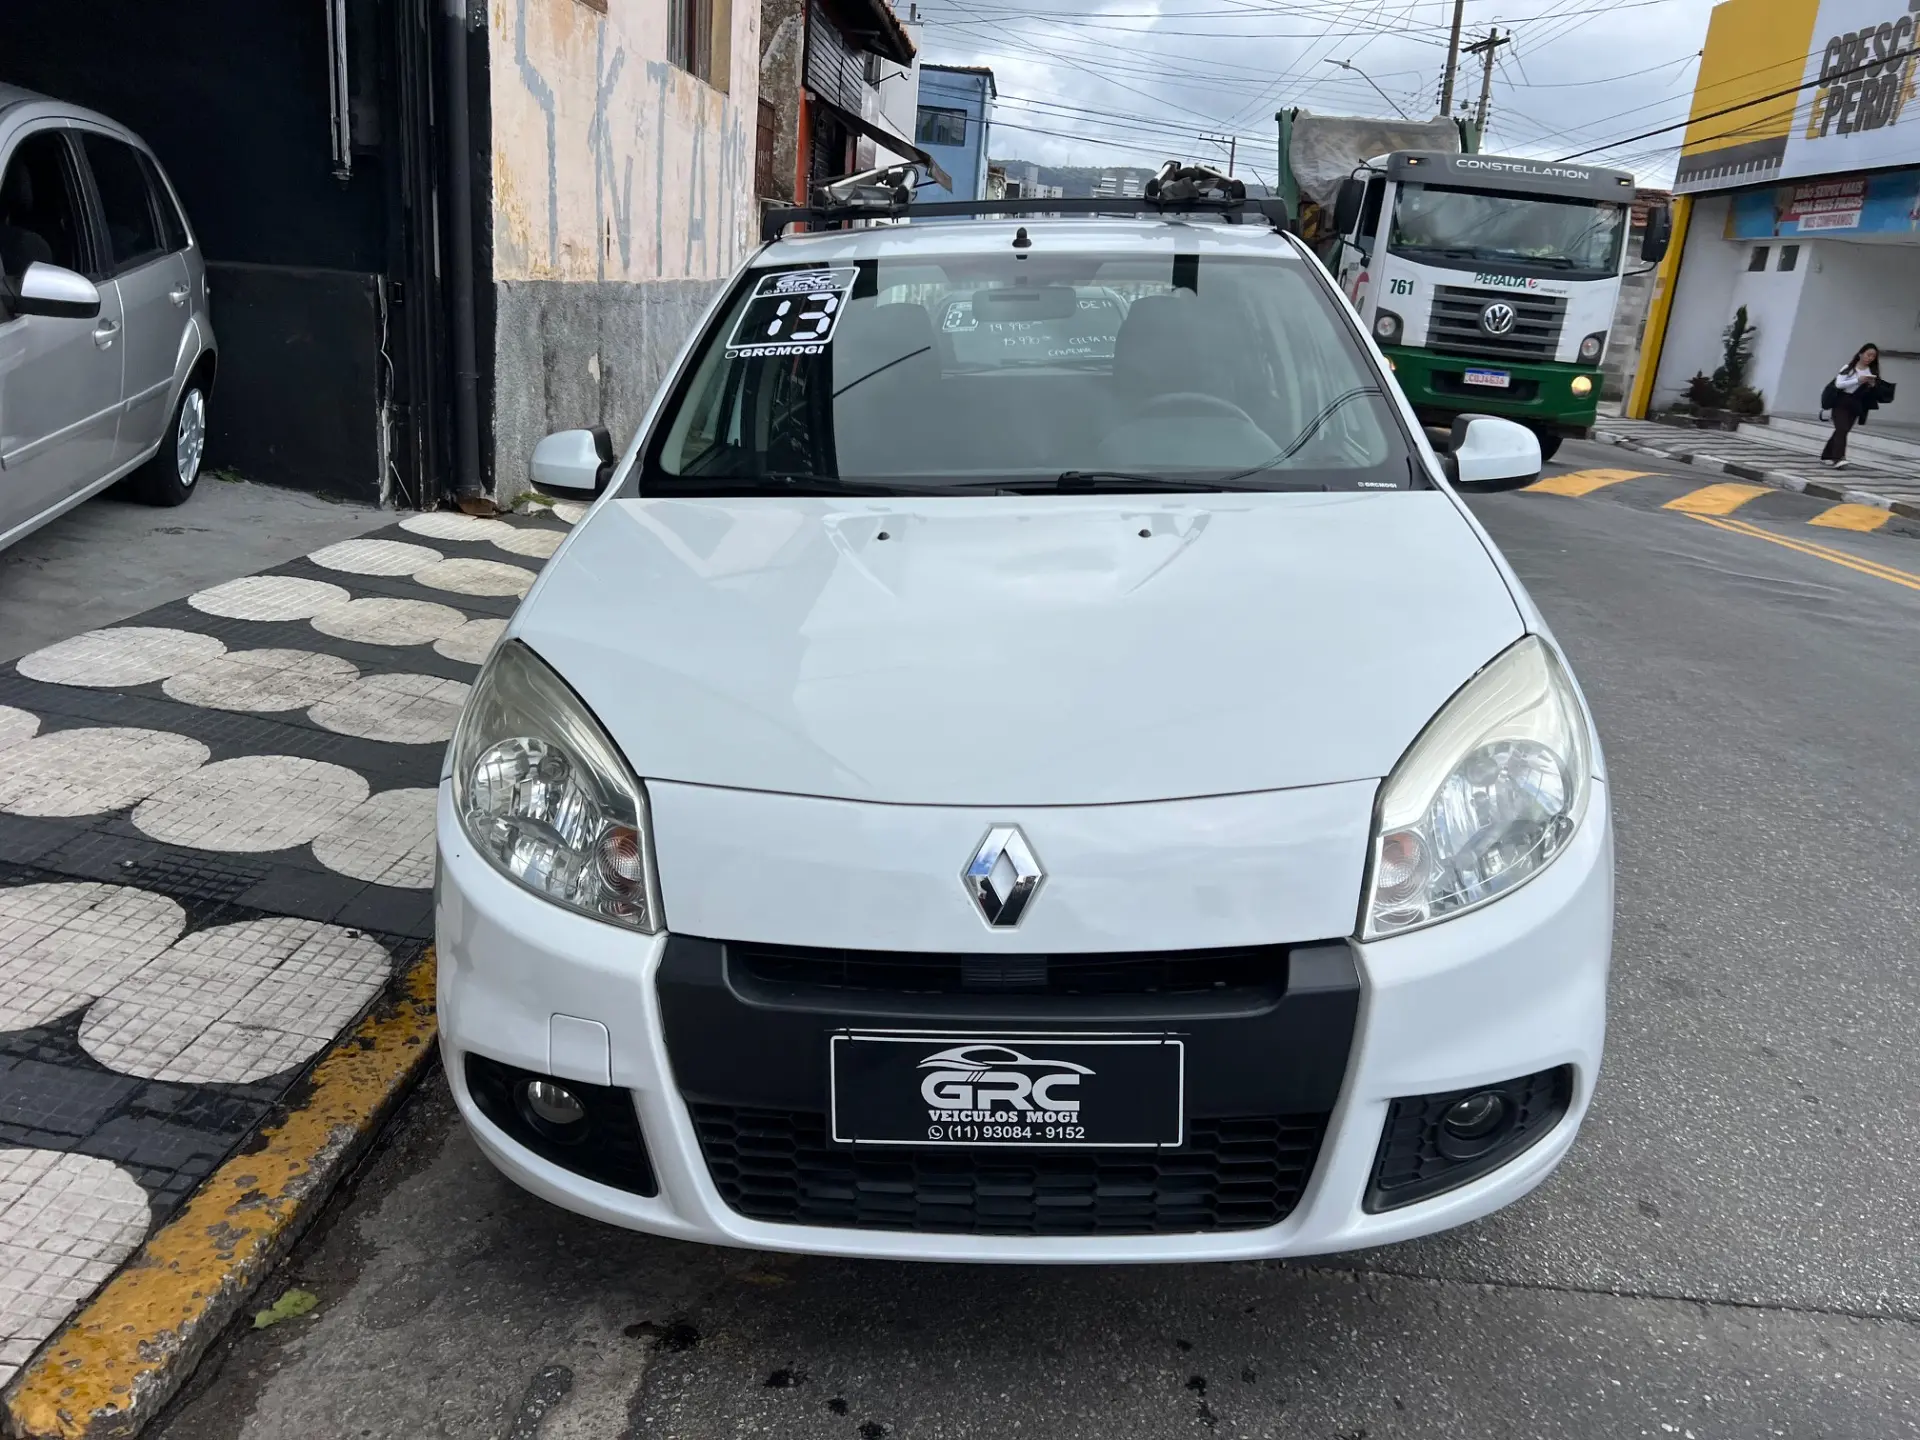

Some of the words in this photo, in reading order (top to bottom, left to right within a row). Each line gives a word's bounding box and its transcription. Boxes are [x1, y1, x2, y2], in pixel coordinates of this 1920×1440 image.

[1456, 159, 1589, 179] CONSTELLATION
[1390, 279, 1414, 295] 761
[1474, 272, 1527, 288] PERALTA
[767, 292, 838, 340] 13
[739, 345, 825, 358] GRCMOGI
[921, 1070, 1080, 1111] GRC
[928, 1109, 1018, 1123] VEICULOS
[1026, 1111, 1078, 1123] MOGI
[948, 1125, 979, 1141] (11)
[983, 1126, 1032, 1139] 93084
[1045, 1126, 1085, 1139] 9152
